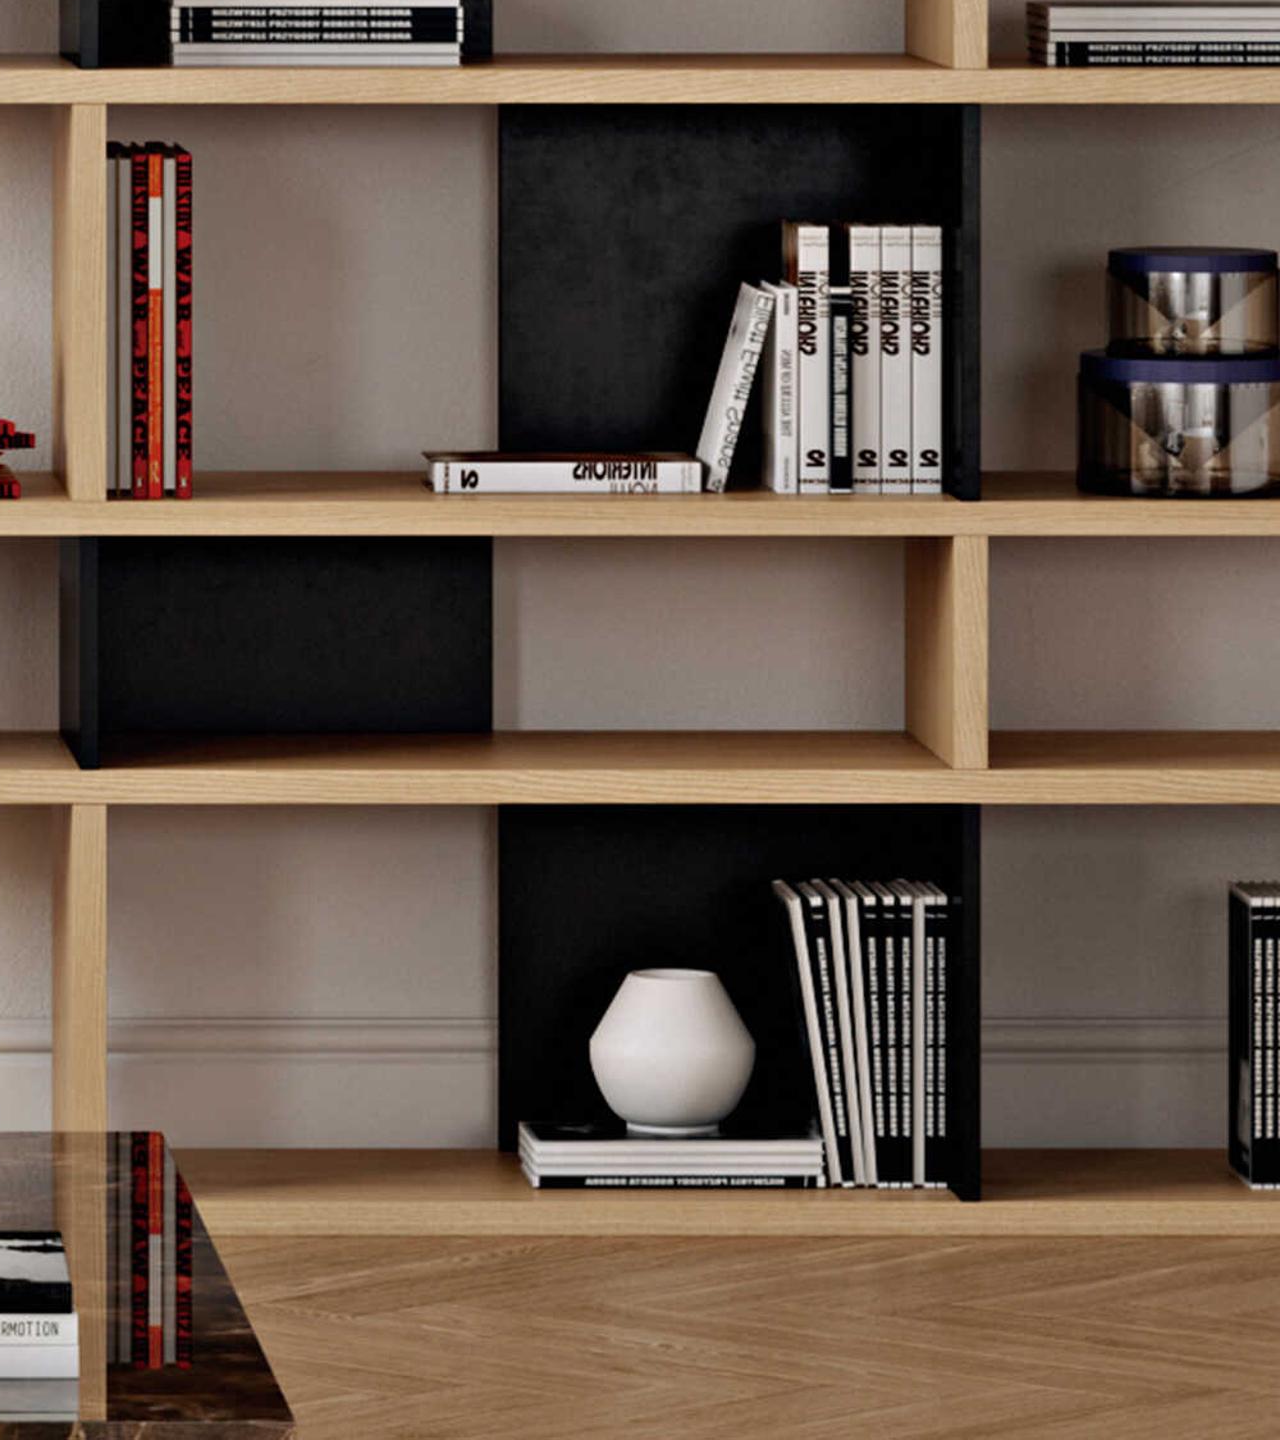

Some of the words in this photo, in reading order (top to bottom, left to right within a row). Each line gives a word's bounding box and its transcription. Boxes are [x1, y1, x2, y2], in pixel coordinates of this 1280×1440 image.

[131, 246, 148, 322] WAR
[175, 246, 192, 322] WAR
[131, 357, 148, 460] PEACE
[175, 357, 192, 460] PEACE
